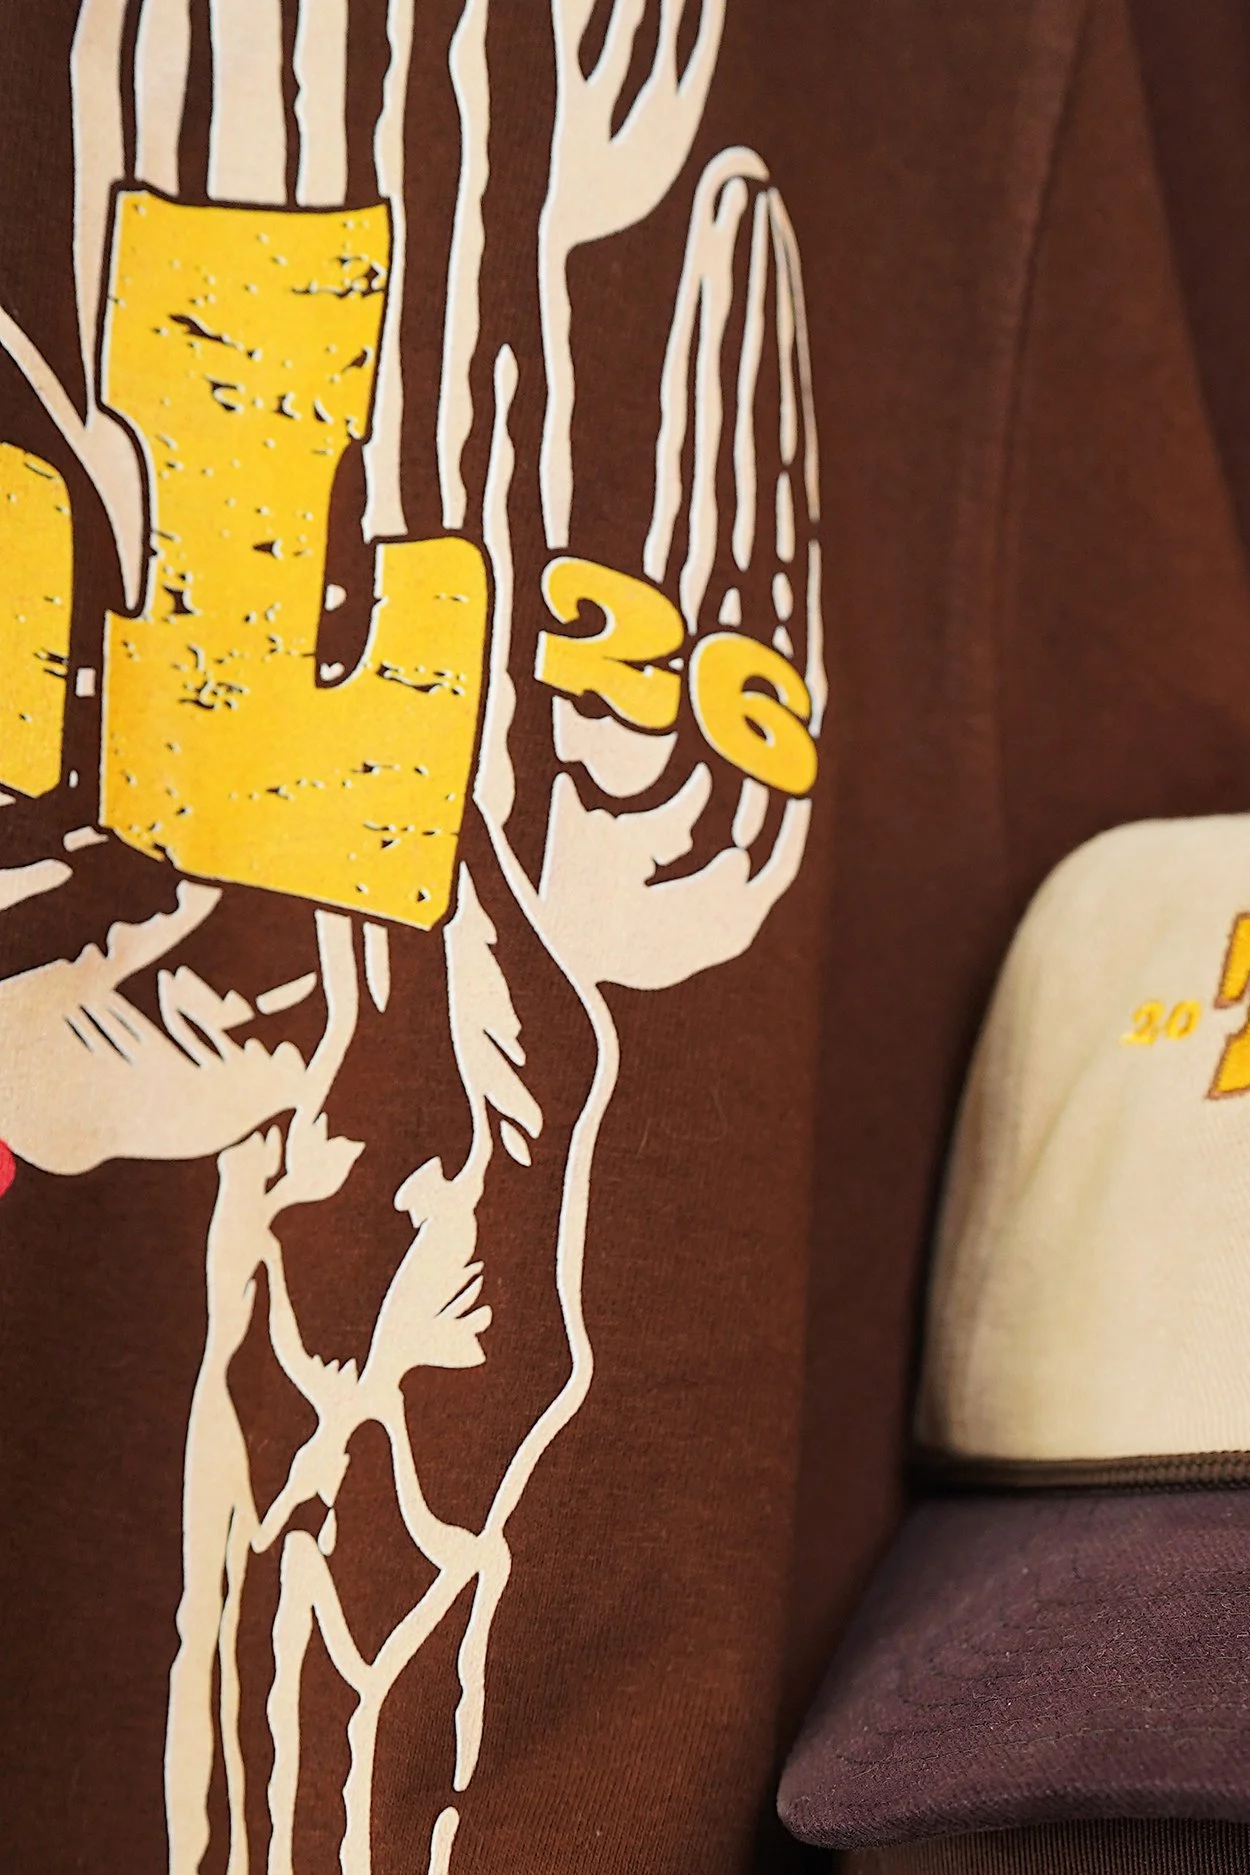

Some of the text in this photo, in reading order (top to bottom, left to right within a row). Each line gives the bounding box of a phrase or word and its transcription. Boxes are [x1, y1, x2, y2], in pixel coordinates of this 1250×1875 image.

[0, 190, 818, 931] L 26
[1121, 1000, 1201, 1047] 20
